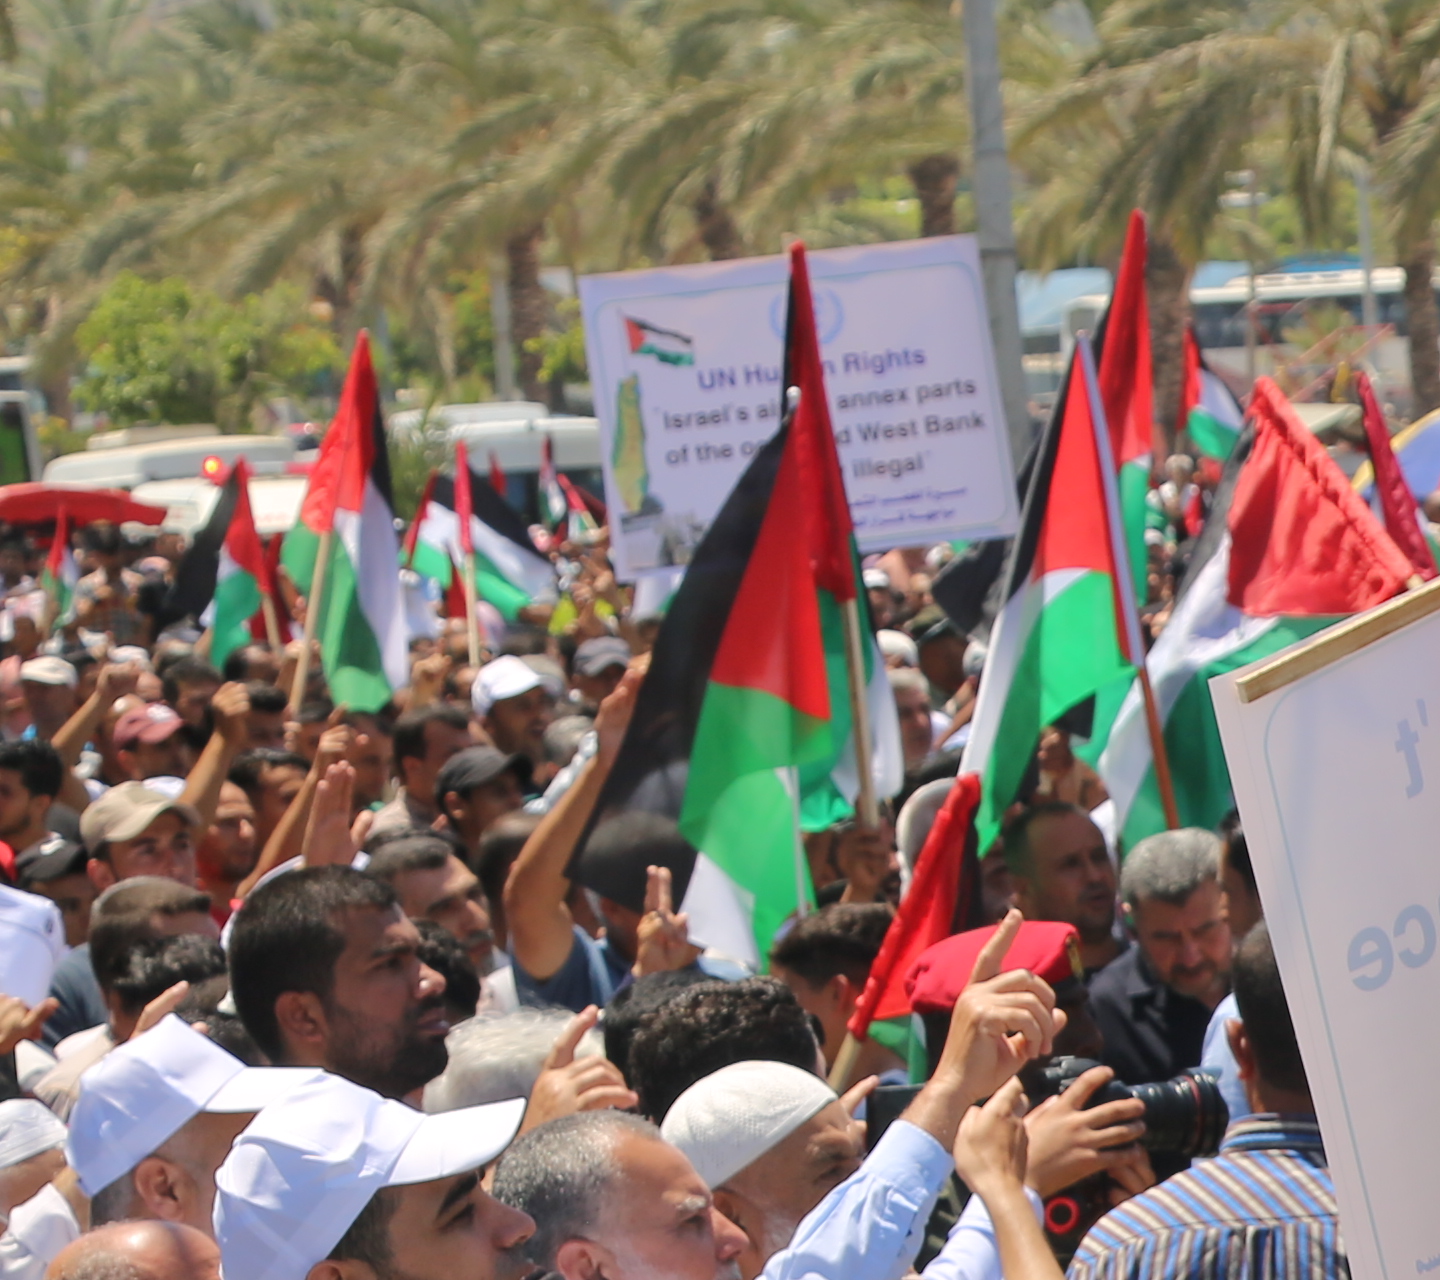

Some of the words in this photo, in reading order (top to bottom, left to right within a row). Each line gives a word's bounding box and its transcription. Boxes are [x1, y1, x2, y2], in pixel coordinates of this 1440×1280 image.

[697, 366, 737, 390] UN
[841, 348, 928, 376] Rights
[836, 386, 908, 410] annex
[915, 378, 977, 407] parts
[855, 420, 918, 441] West
[924, 411, 986, 434] Bank
[664, 444, 690, 464] of
[693, 441, 733, 461] the
